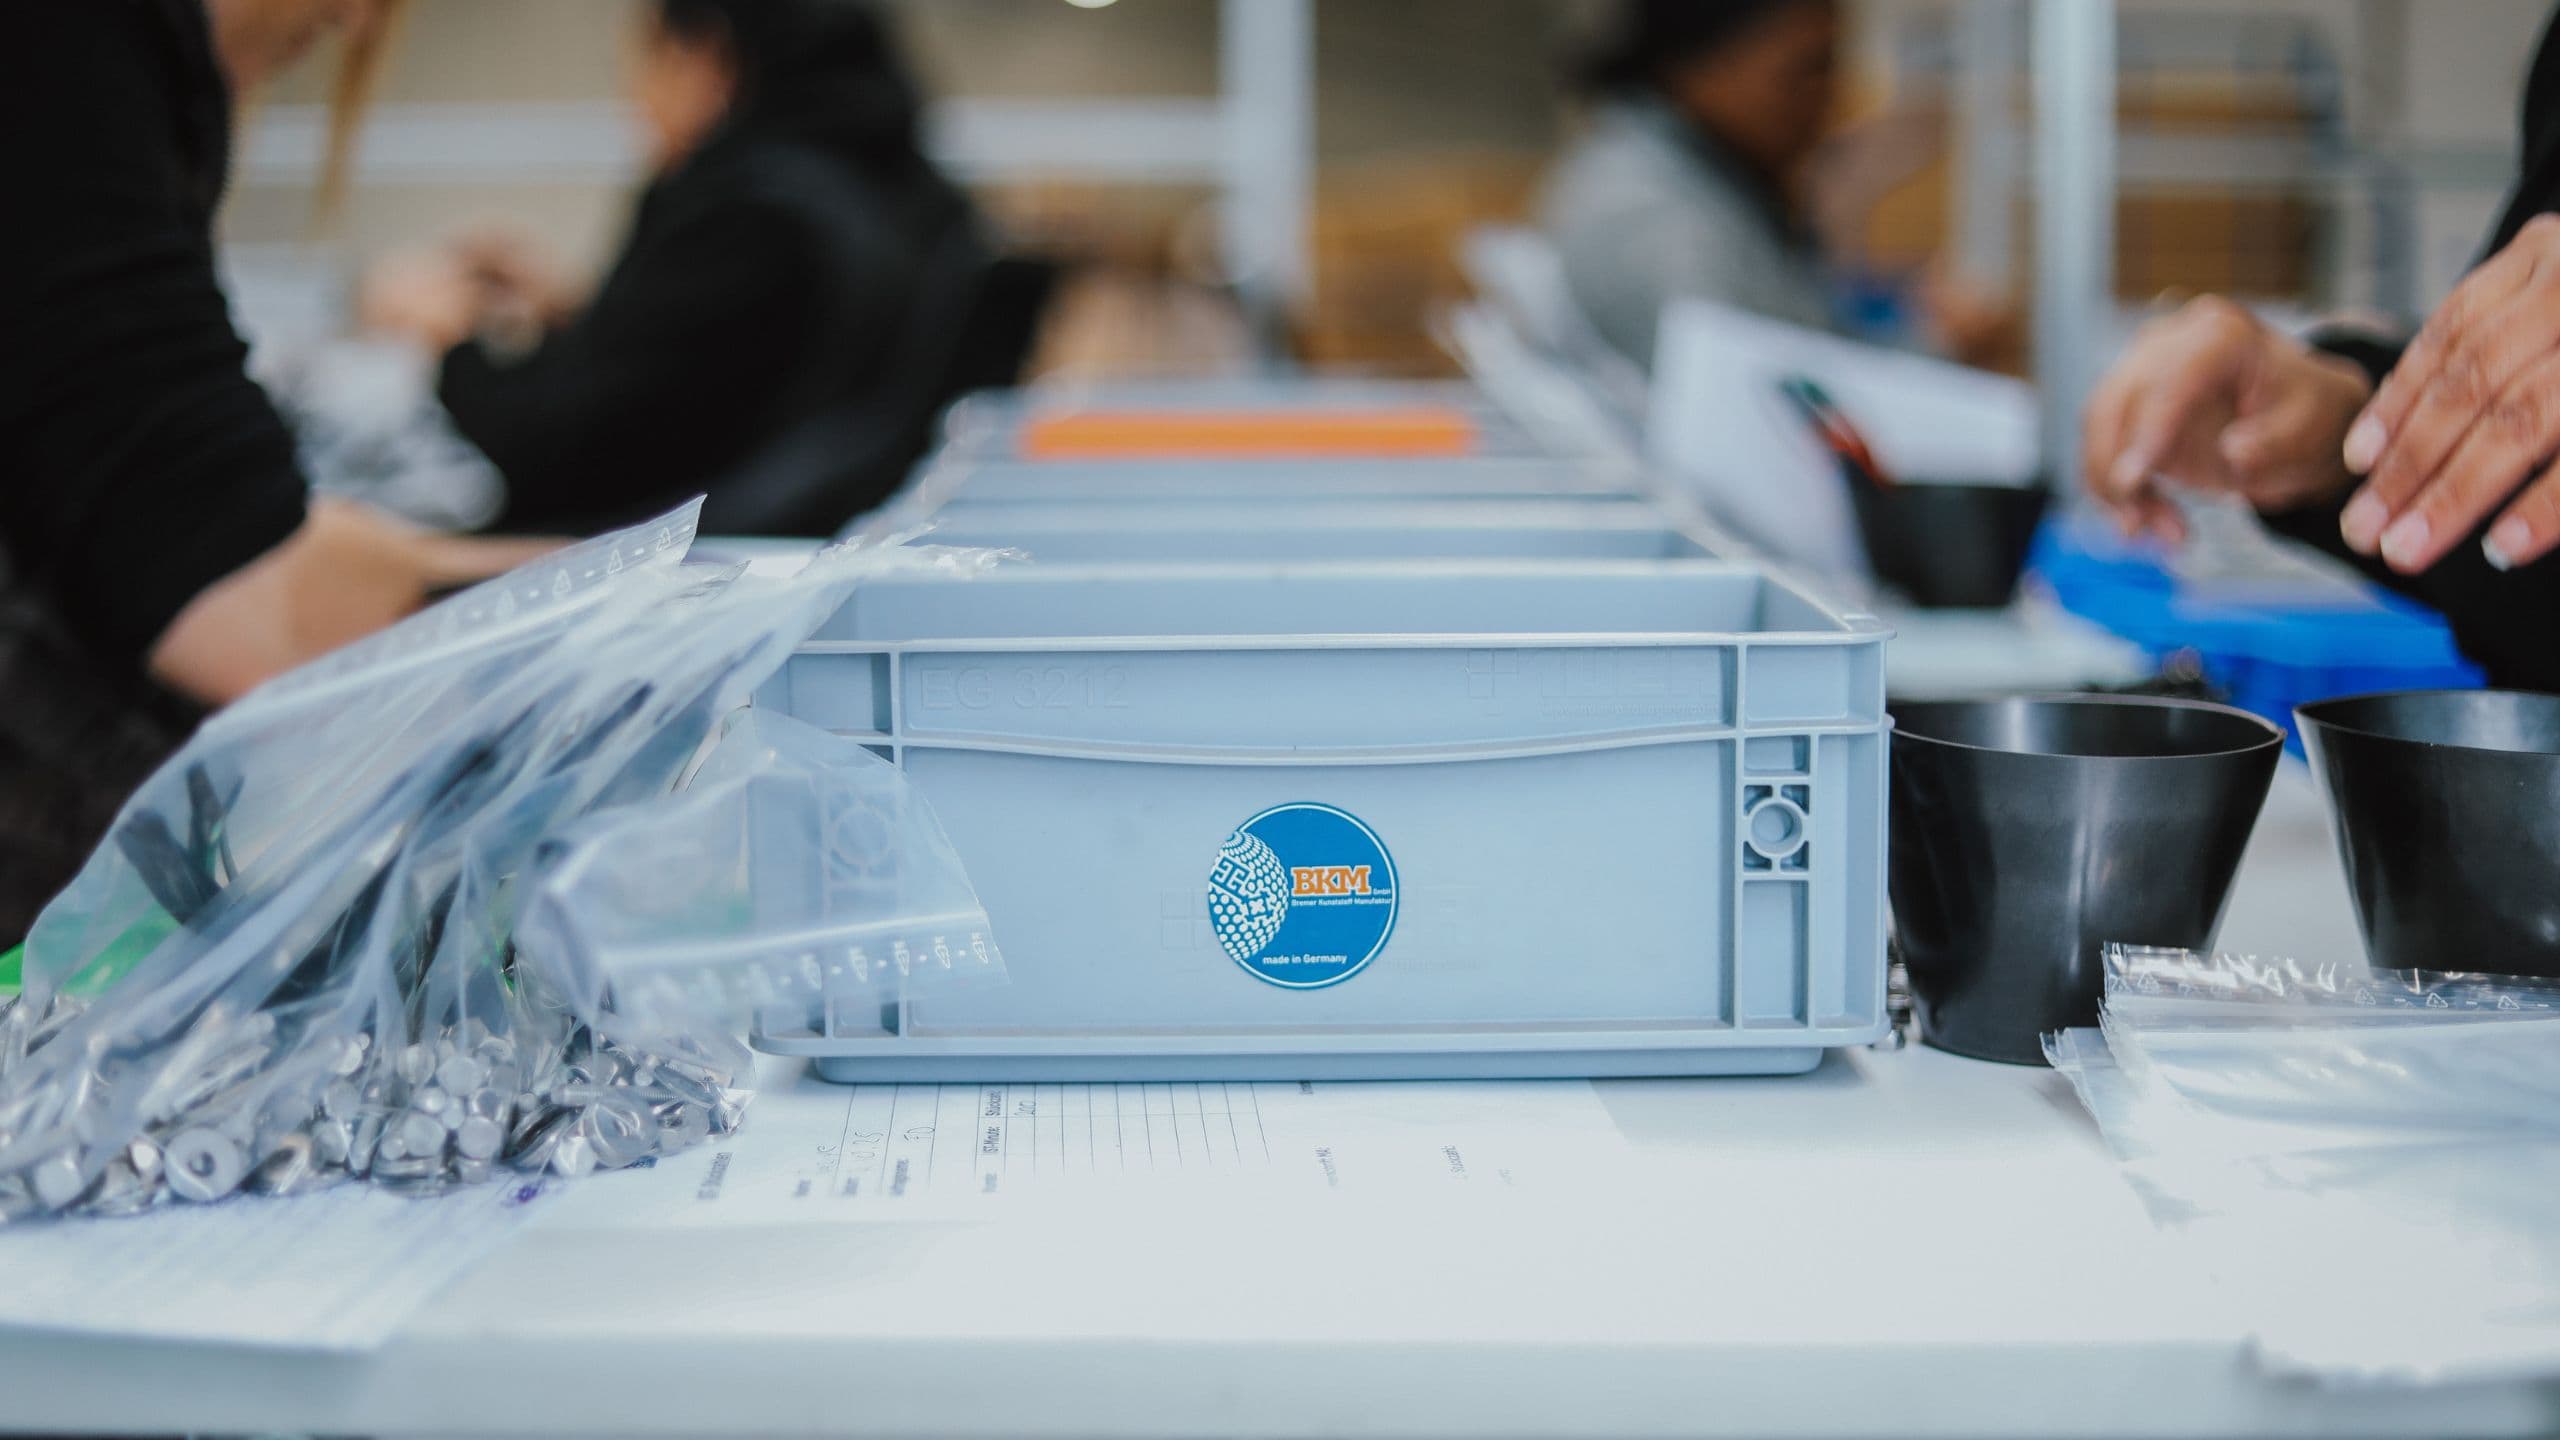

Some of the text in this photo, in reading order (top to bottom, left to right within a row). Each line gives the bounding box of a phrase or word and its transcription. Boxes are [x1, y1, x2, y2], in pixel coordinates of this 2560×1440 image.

[920, 664, 1130, 710] EG 3212
[1291, 865, 1371, 896] BKM
[1318, 898, 1353, 906] Kunststoff
[1263, 953, 1347, 964] made in Germany
